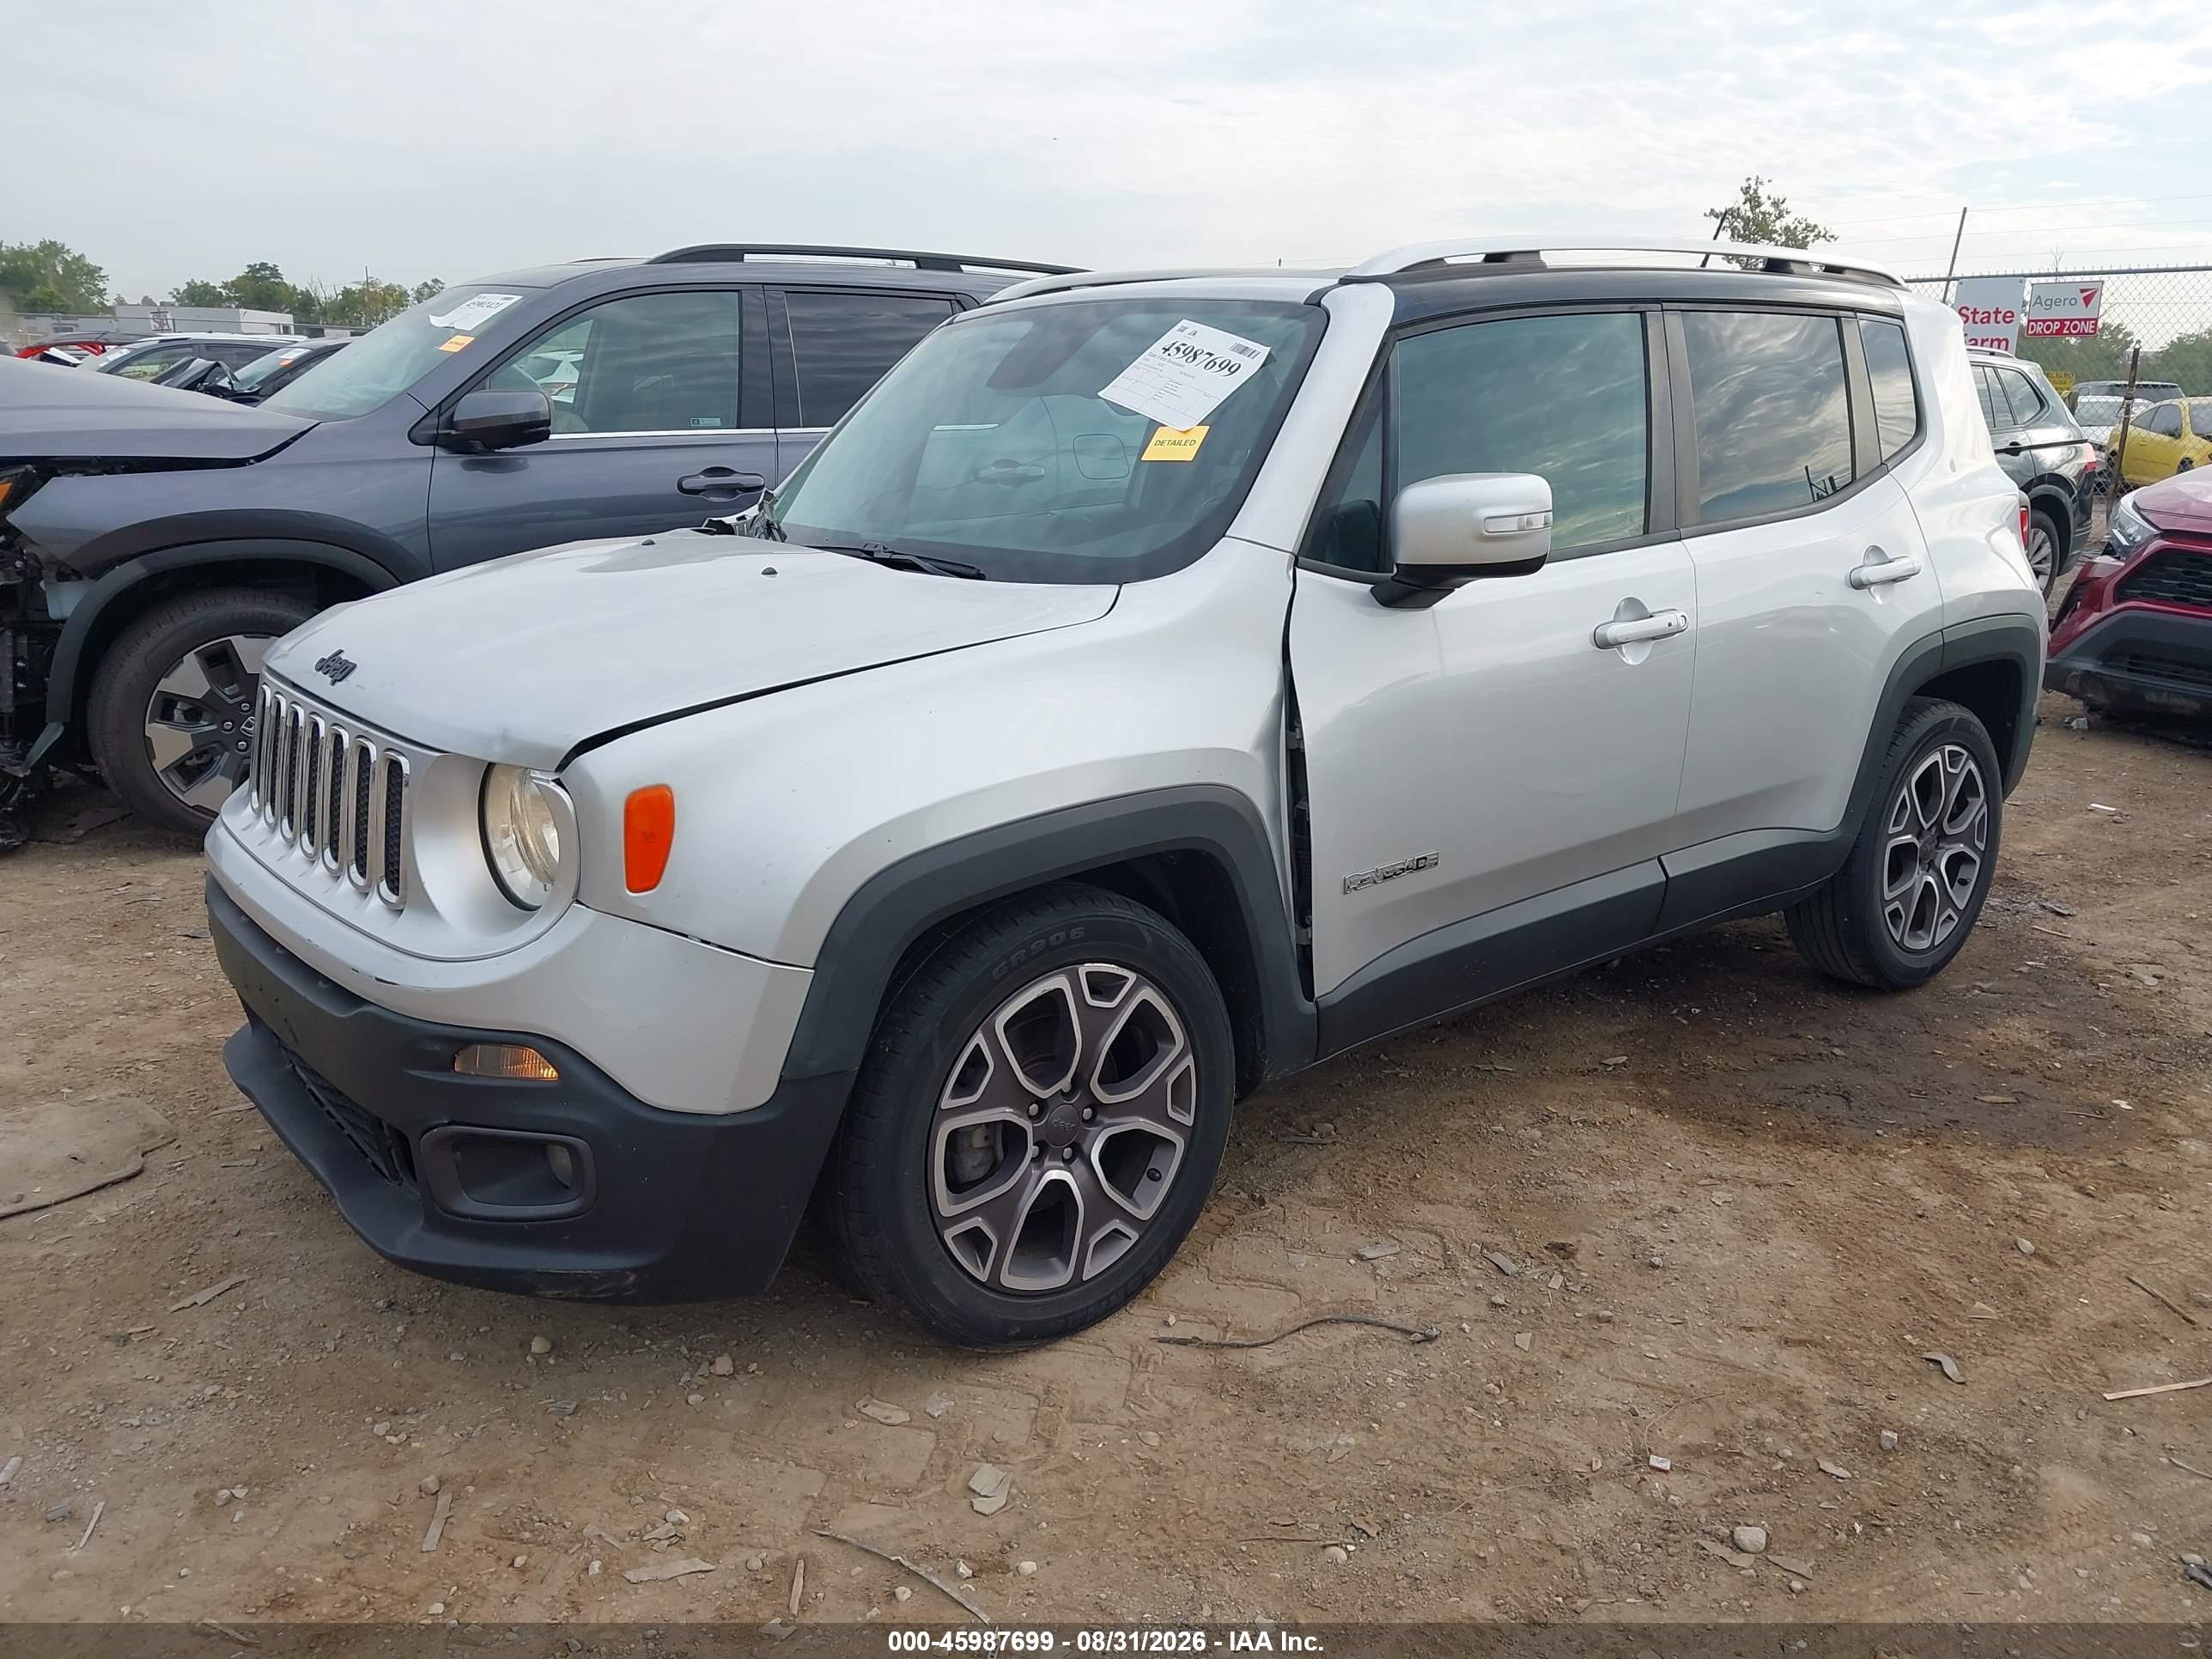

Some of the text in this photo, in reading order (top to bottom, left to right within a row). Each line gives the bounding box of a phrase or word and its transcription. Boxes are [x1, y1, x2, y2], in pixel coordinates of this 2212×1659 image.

[2032, 295, 2078, 310] Agero
[1958, 306, 2015, 325] State
[2028, 319, 2097, 335] DROP ZONE
[1964, 333, 2009, 351] arm
[1161, 340, 1242, 377] 45987699
[1154, 439, 1196, 447] DETAILED
[314, 648, 357, 686] Jeep
[1343, 849, 1439, 895] RENEGADE
[992, 927, 1085, 979] GR906
